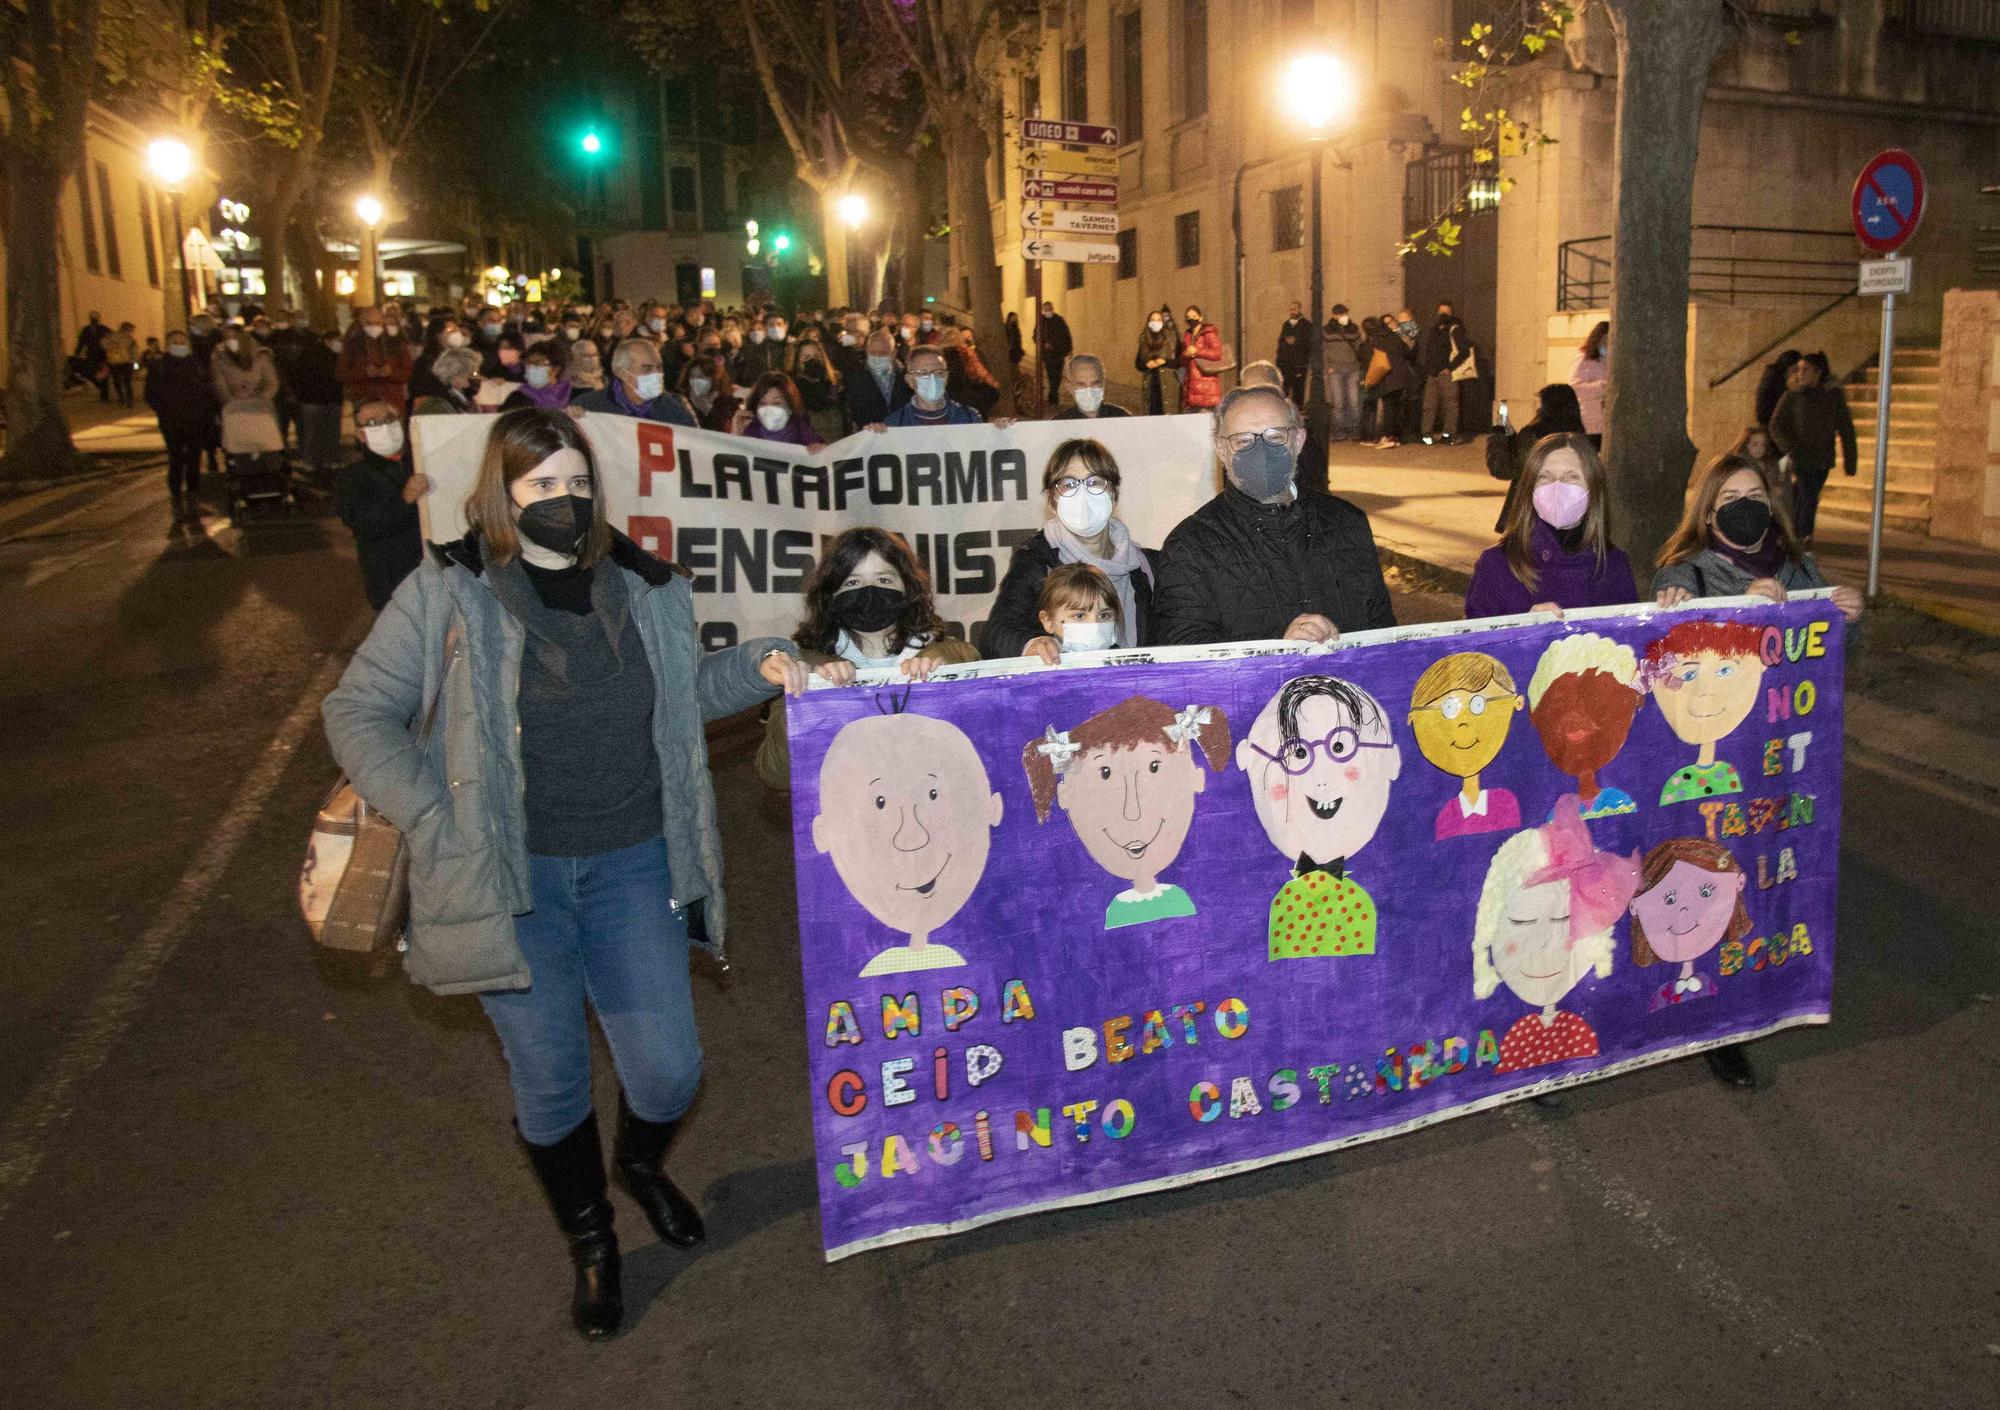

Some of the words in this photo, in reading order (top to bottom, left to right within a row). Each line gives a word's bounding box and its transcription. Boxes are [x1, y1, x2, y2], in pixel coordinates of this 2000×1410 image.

[1029, 123, 1062, 138] UNED
[1070, 222, 1116, 231] TAVERNES
[1082, 215, 1116, 223] GANDIA
[1088, 252, 1116, 262] jutjats
[637, 422, 1028, 511] PLATAFORMA
[1759, 622, 1829, 666] QUE
[1766, 680, 1816, 723] NO
[1763, 731, 1813, 776] ET
[1757, 847, 1797, 889] LA
[825, 978, 1035, 1047] AMPA
[1061, 998, 1250, 1072] BEATO
